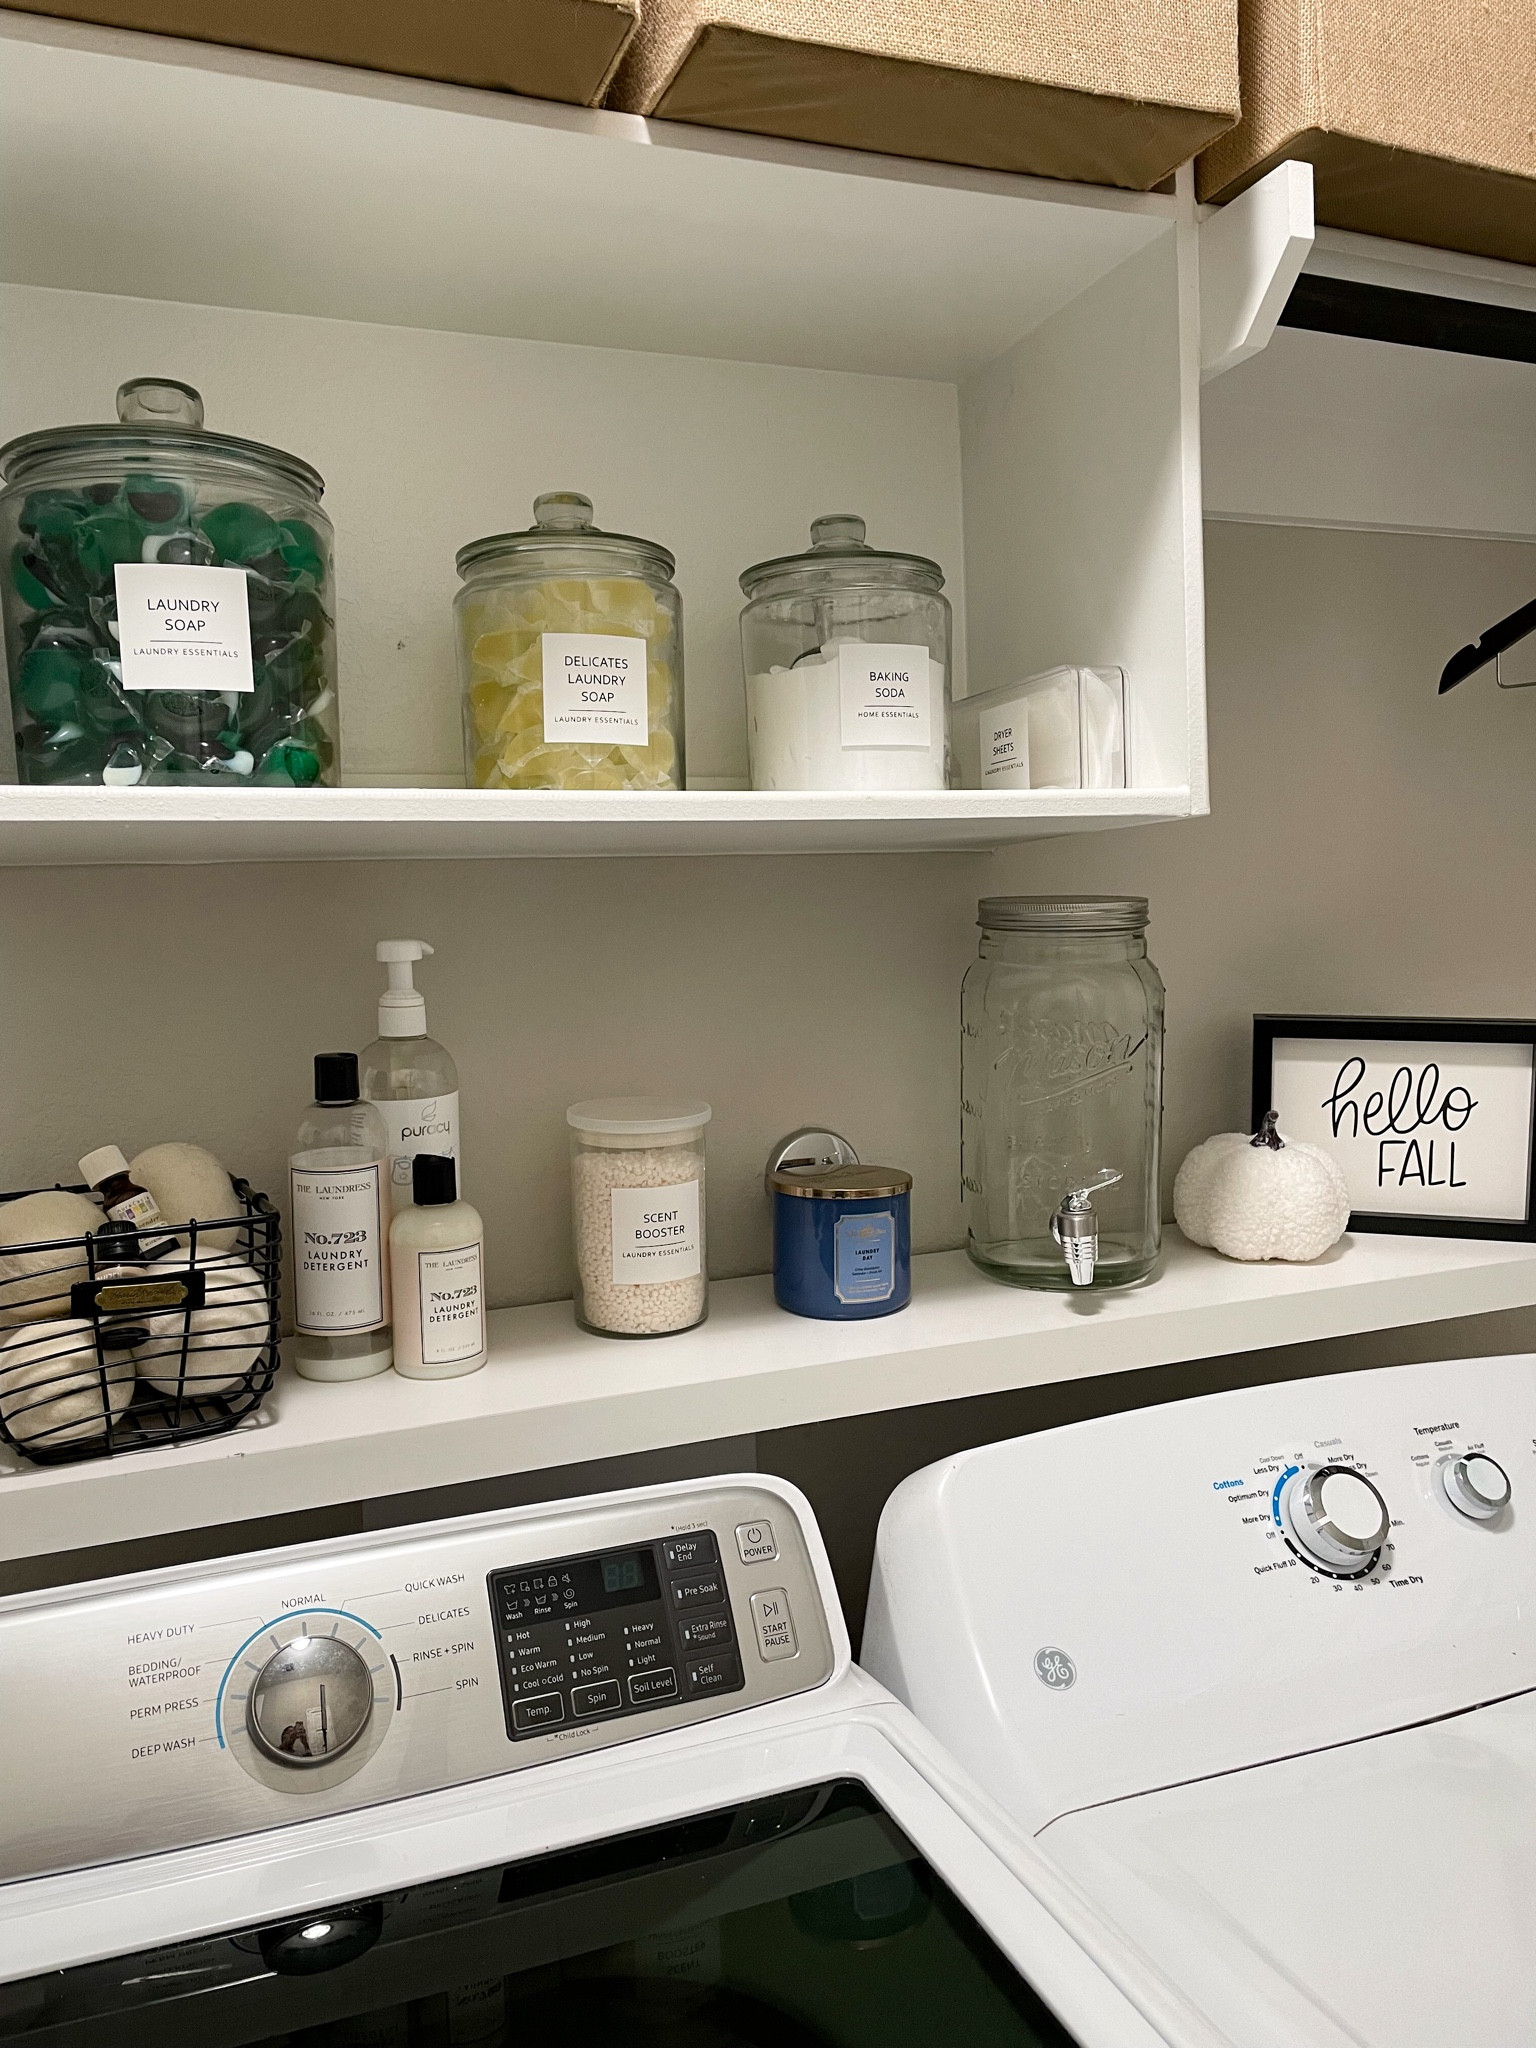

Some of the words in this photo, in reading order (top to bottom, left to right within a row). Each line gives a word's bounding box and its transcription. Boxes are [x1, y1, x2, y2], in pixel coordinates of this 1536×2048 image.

[147, 598, 220, 612] LAUNDRY
[165, 619, 206, 631] SOAP
[133, 648, 179, 656] LAUNDRY
[183, 648, 239, 658] ESSENTIALS
[564, 655, 628, 669] DELICATES
[568, 674, 626, 686] LAUNDRY
[869, 672, 909, 682] BAKING
[581, 691, 614, 702] SOAP
[875, 688, 905, 698] SODA
[595, 717, 639, 725] ESSENTIALS
[994, 728, 1012, 741] DRYER
[993, 742, 1014, 756] SHEETS
[1321, 1056, 1479, 1138] hello
[401, 1121, 450, 1141] puracy
[1378, 1139, 1466, 1187] FALL
[297, 1184, 311, 1193] THE
[316, 1182, 371, 1194] LAUNDRESS
[643, 1210, 678, 1224] SCENT
[304, 1230, 367, 1245] No.723
[635, 1224, 685, 1239] BOOSTER
[308, 1249, 363, 1260] LAUNDRY
[622, 1251, 657, 1259] LAUNDRY
[659, 1244, 695, 1257] ESSENTIALS
[855, 1247, 880, 1256] LAUNDRY
[304, 1259, 369, 1272] DETERGENT
[430, 1285, 478, 1302] No.723
[434, 1300, 475, 1314] LAUNDRY
[429, 1307, 479, 1323] DETERGENT
[1413, 1422, 1460, 1436] Temperature
[1314, 1437, 1342, 1448] Casuals
[1268, 1464, 1280, 1473] Dry
[1356, 1462, 1367, 1470] Dry
[1213, 1479, 1244, 1490] Cottons
[1228, 1492, 1257, 1503] Optimum
[1259, 1514, 1271, 1522] Dry
[1265, 1531, 1276, 1540] Off
[675, 1542, 697, 1553] Delay
[743, 1545, 773, 1557] POWER
[1385, 1543, 1396, 1552] 70
[678, 1552, 693, 1562] End
[1253, 1565, 1273, 1575] Quick
[1273, 1560, 1288, 1570] Fluff
[1288, 1559, 1297, 1567] 10
[1381, 1563, 1392, 1572] 60
[404, 1578, 435, 1593] QUICK
[437, 1574, 465, 1586] WASH
[1310, 1576, 1320, 1584] 20
[1370, 1578, 1381, 1586] 50
[1388, 1577, 1410, 1589] Time
[1409, 1575, 1424, 1584] Dry
[684, 1587, 698, 1597] Pre
[699, 1582, 718, 1593] Soak
[1333, 1584, 1343, 1593] 30
[1353, 1584, 1364, 1592] 40
[281, 1593, 326, 1609] NORMAL
[564, 1600, 578, 1610] Spin
[418, 1606, 470, 1625] DELICATES
[505, 1612, 523, 1621] Wash
[534, 1606, 552, 1615] Rinse
[573, 1618, 591, 1629] High
[632, 1622, 654, 1633] Heavy
[691, 1622, 709, 1633] Extra
[709, 1619, 728, 1630] Rinse
[762, 1621, 787, 1635] START
[127, 1629, 164, 1645] HEAVY
[166, 1624, 195, 1638] DUTY
[516, 1631, 531, 1641] Hot
[576, 1632, 606, 1644] Medium
[697, 1632, 716, 1641] Sound
[765, 1634, 790, 1647] PAUSE
[634, 1636, 661, 1649] Normal
[412, 1648, 442, 1662] RINSE
[451, 1642, 475, 1655] SPIN
[518, 1646, 541, 1657] Warm
[578, 1652, 594, 1661] Low
[637, 1654, 656, 1665] Light
[128, 1657, 182, 1676] BEDDING/
[520, 1664, 534, 1673] Eco
[535, 1659, 557, 1670] Warm
[581, 1669, 592, 1678] No
[592, 1664, 609, 1675] Spin
[698, 1663, 714, 1675] Self
[128, 1665, 201, 1688] WATERPROOF
[700, 1675, 723, 1685] Clean
[455, 1677, 479, 1690] SPIN
[523, 1679, 540, 1690] Cool
[633, 1682, 650, 1694] Soil
[651, 1676, 673, 1690] Level
[587, 1693, 607, 1705] Spin
[130, 1704, 161, 1720] PERM
[164, 1697, 199, 1713] PRESS
[526, 1705, 552, 1717] Temp.
[558, 1732, 575, 1741] Child
[576, 1728, 591, 1738] Lock
[131, 1743, 161, 1759] DEEP
[162, 1736, 196, 1752] WASH
